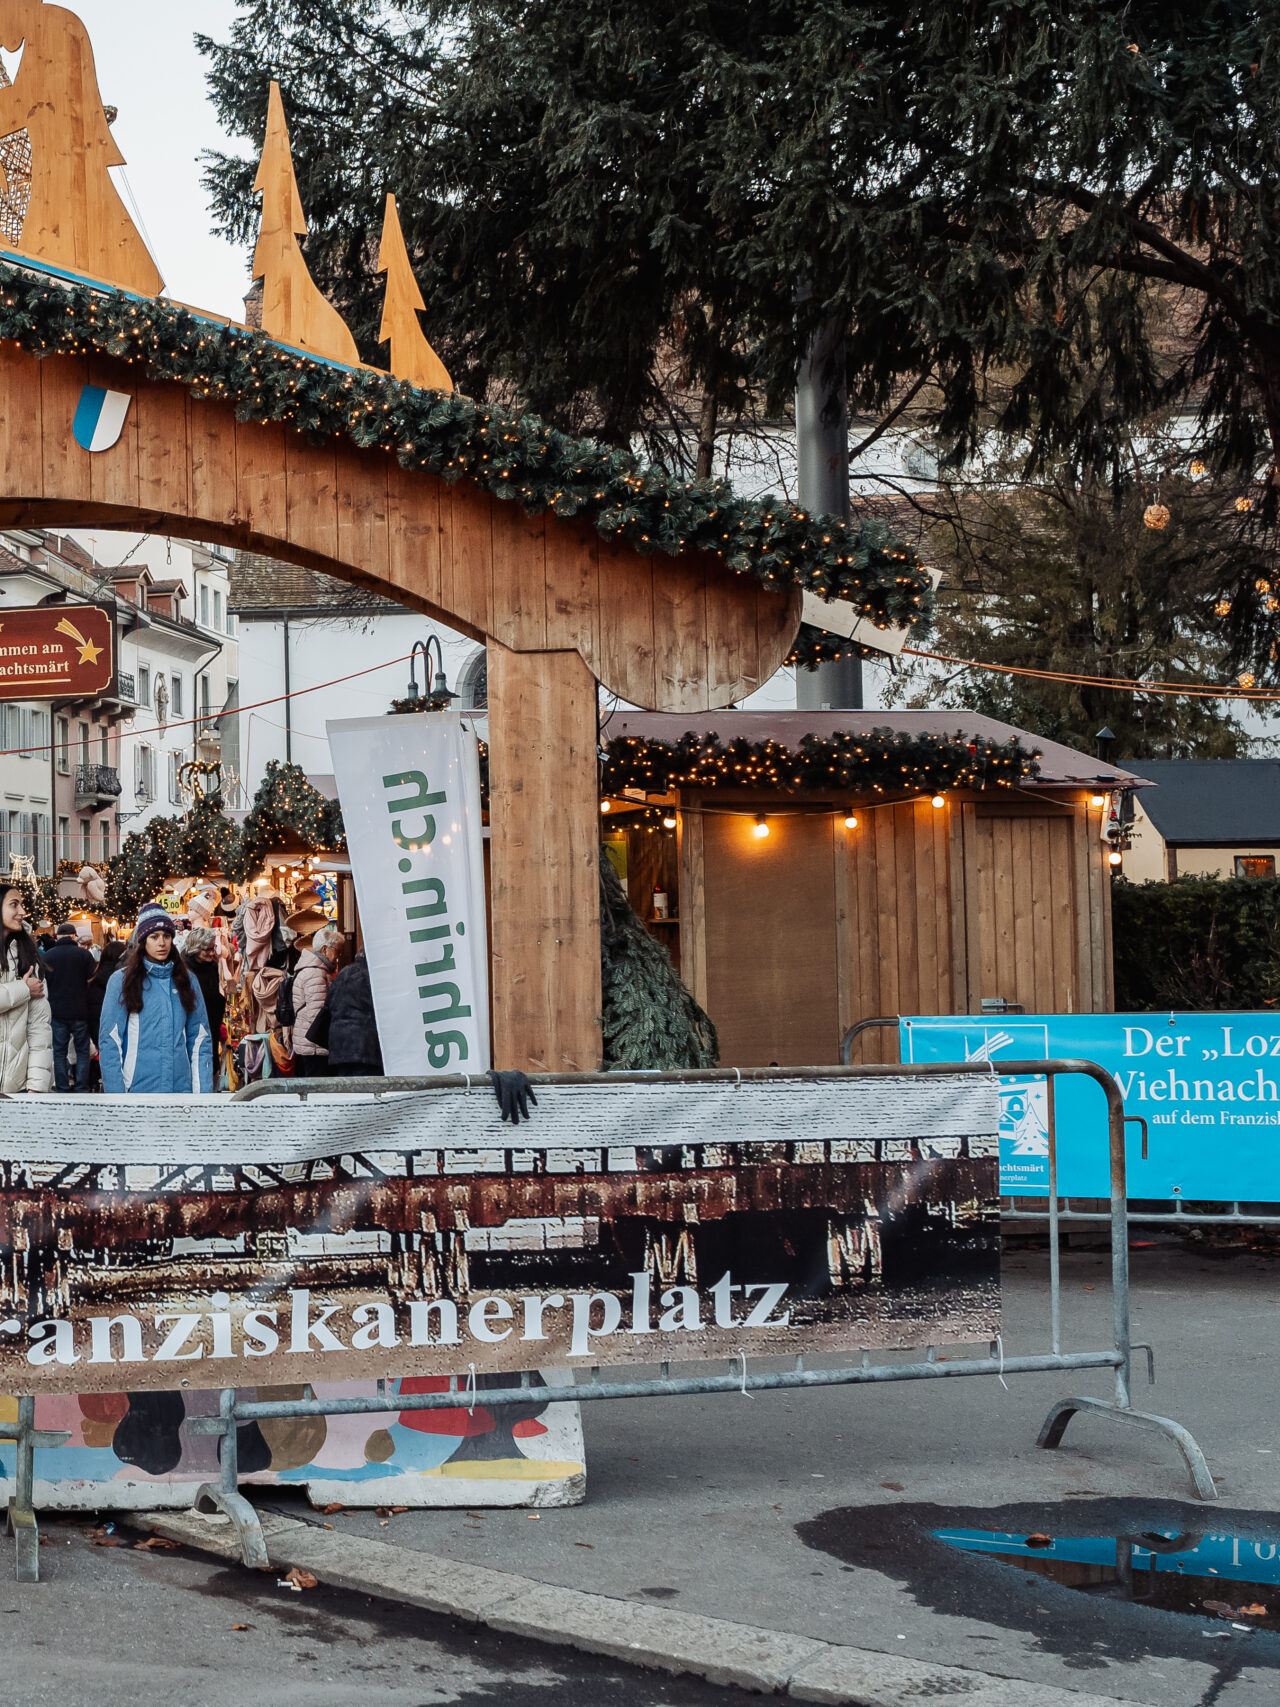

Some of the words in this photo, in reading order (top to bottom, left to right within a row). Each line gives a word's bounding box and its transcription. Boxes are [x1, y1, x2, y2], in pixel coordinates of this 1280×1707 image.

[42, 644, 64, 654] am
[1122, 1027, 1191, 1057] Der
[1114, 1068, 1280, 1102] Wiehnach
[1152, 1109, 1179, 1125] auf
[1180, 1110, 1216, 1125] dem
